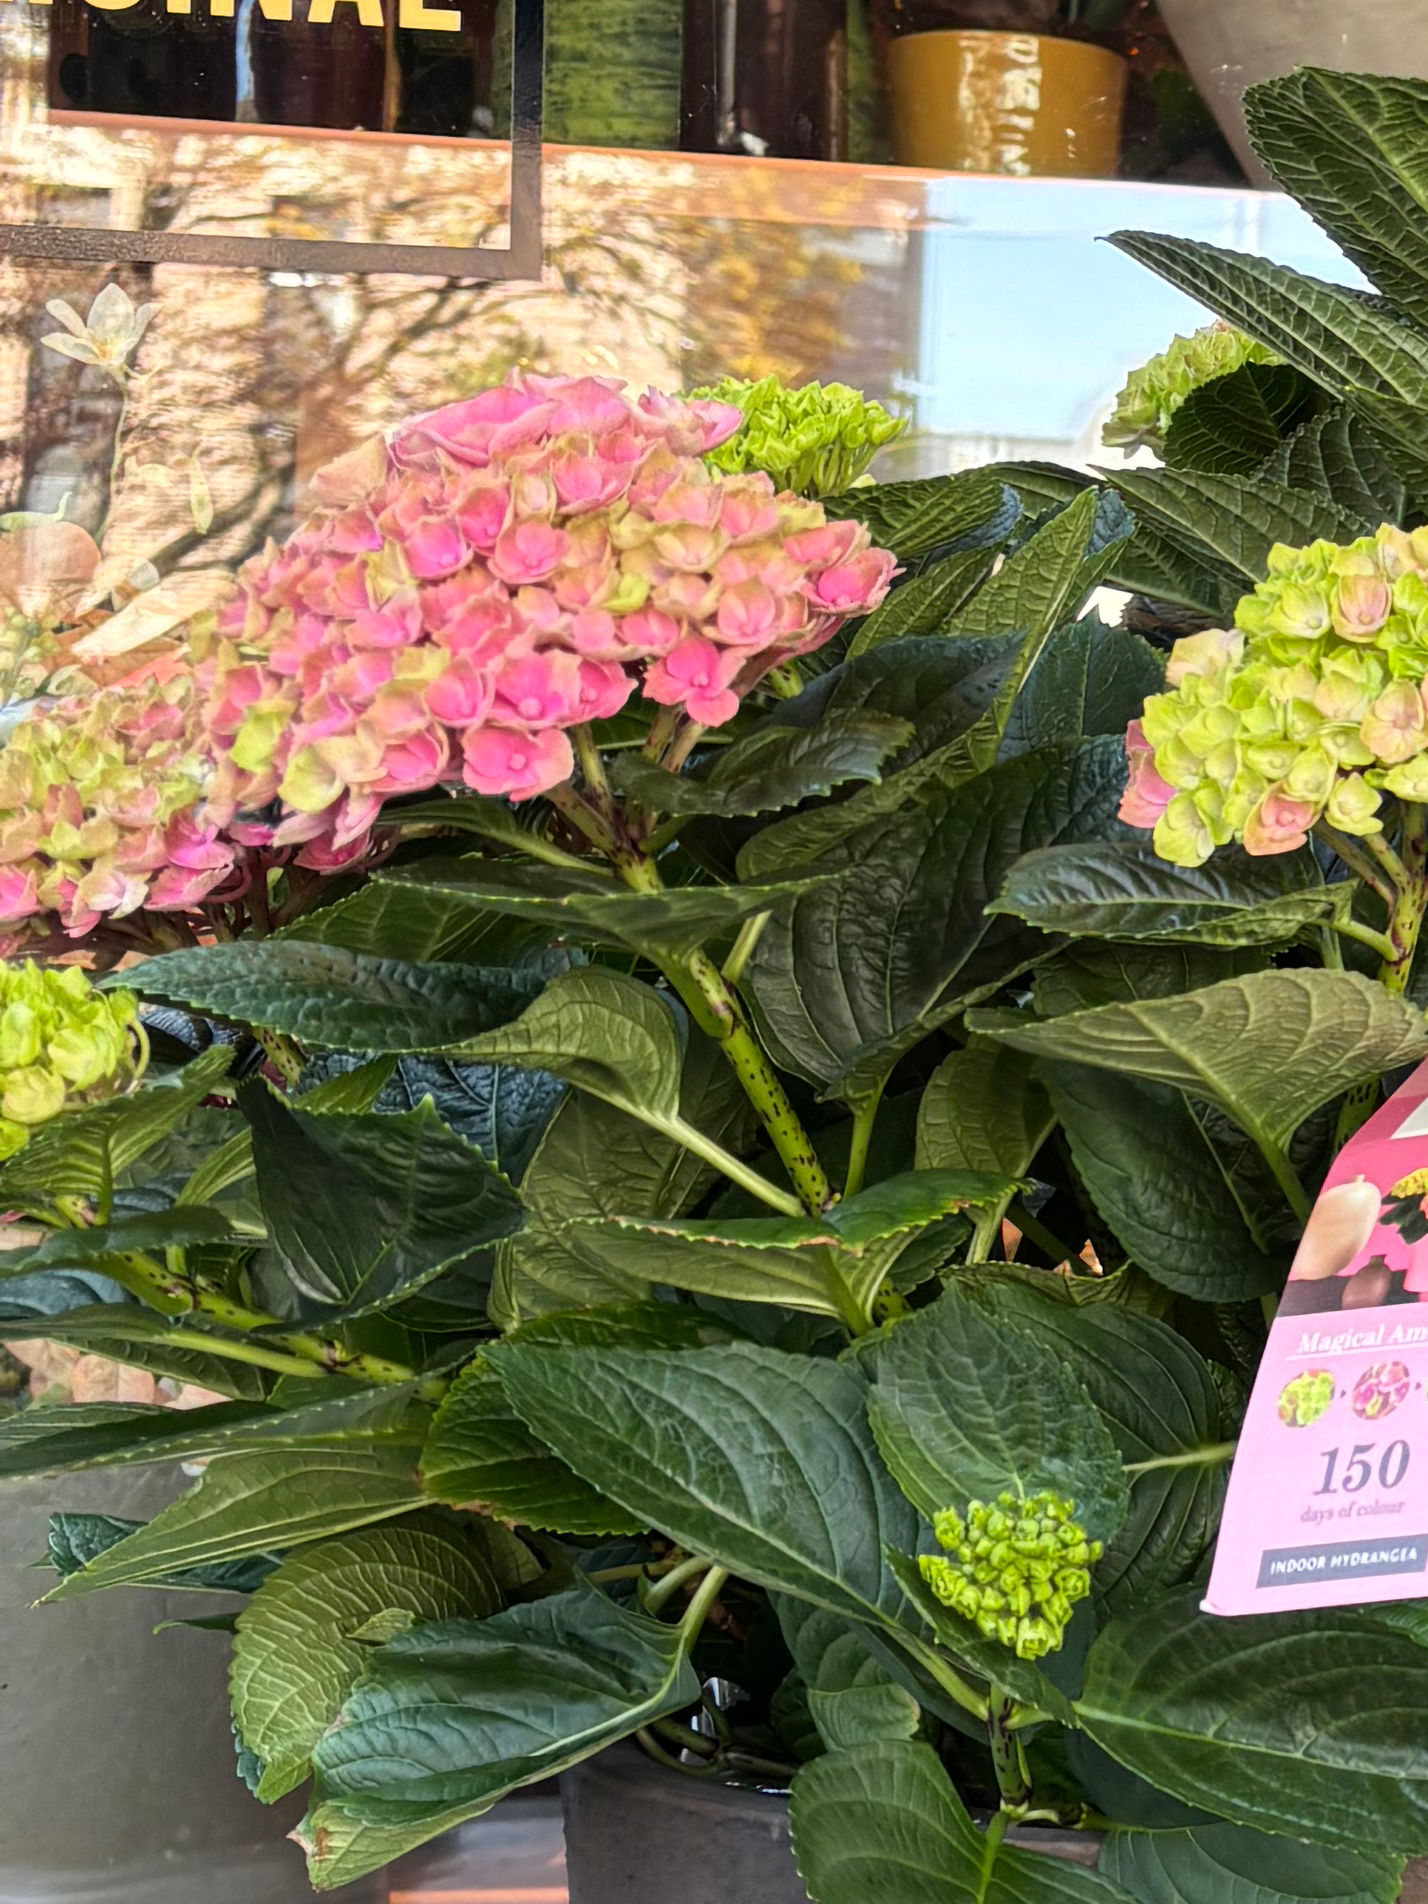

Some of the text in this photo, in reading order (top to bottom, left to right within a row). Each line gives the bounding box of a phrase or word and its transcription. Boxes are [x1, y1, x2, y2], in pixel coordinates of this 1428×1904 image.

[1297, 1323, 1385, 1355] Magical
[1313, 1439, 1411, 1496] 150
[1300, 1499, 1406, 1526] days of colour
[1270, 1547, 1418, 1574] INDOOR HYDRANGEA
